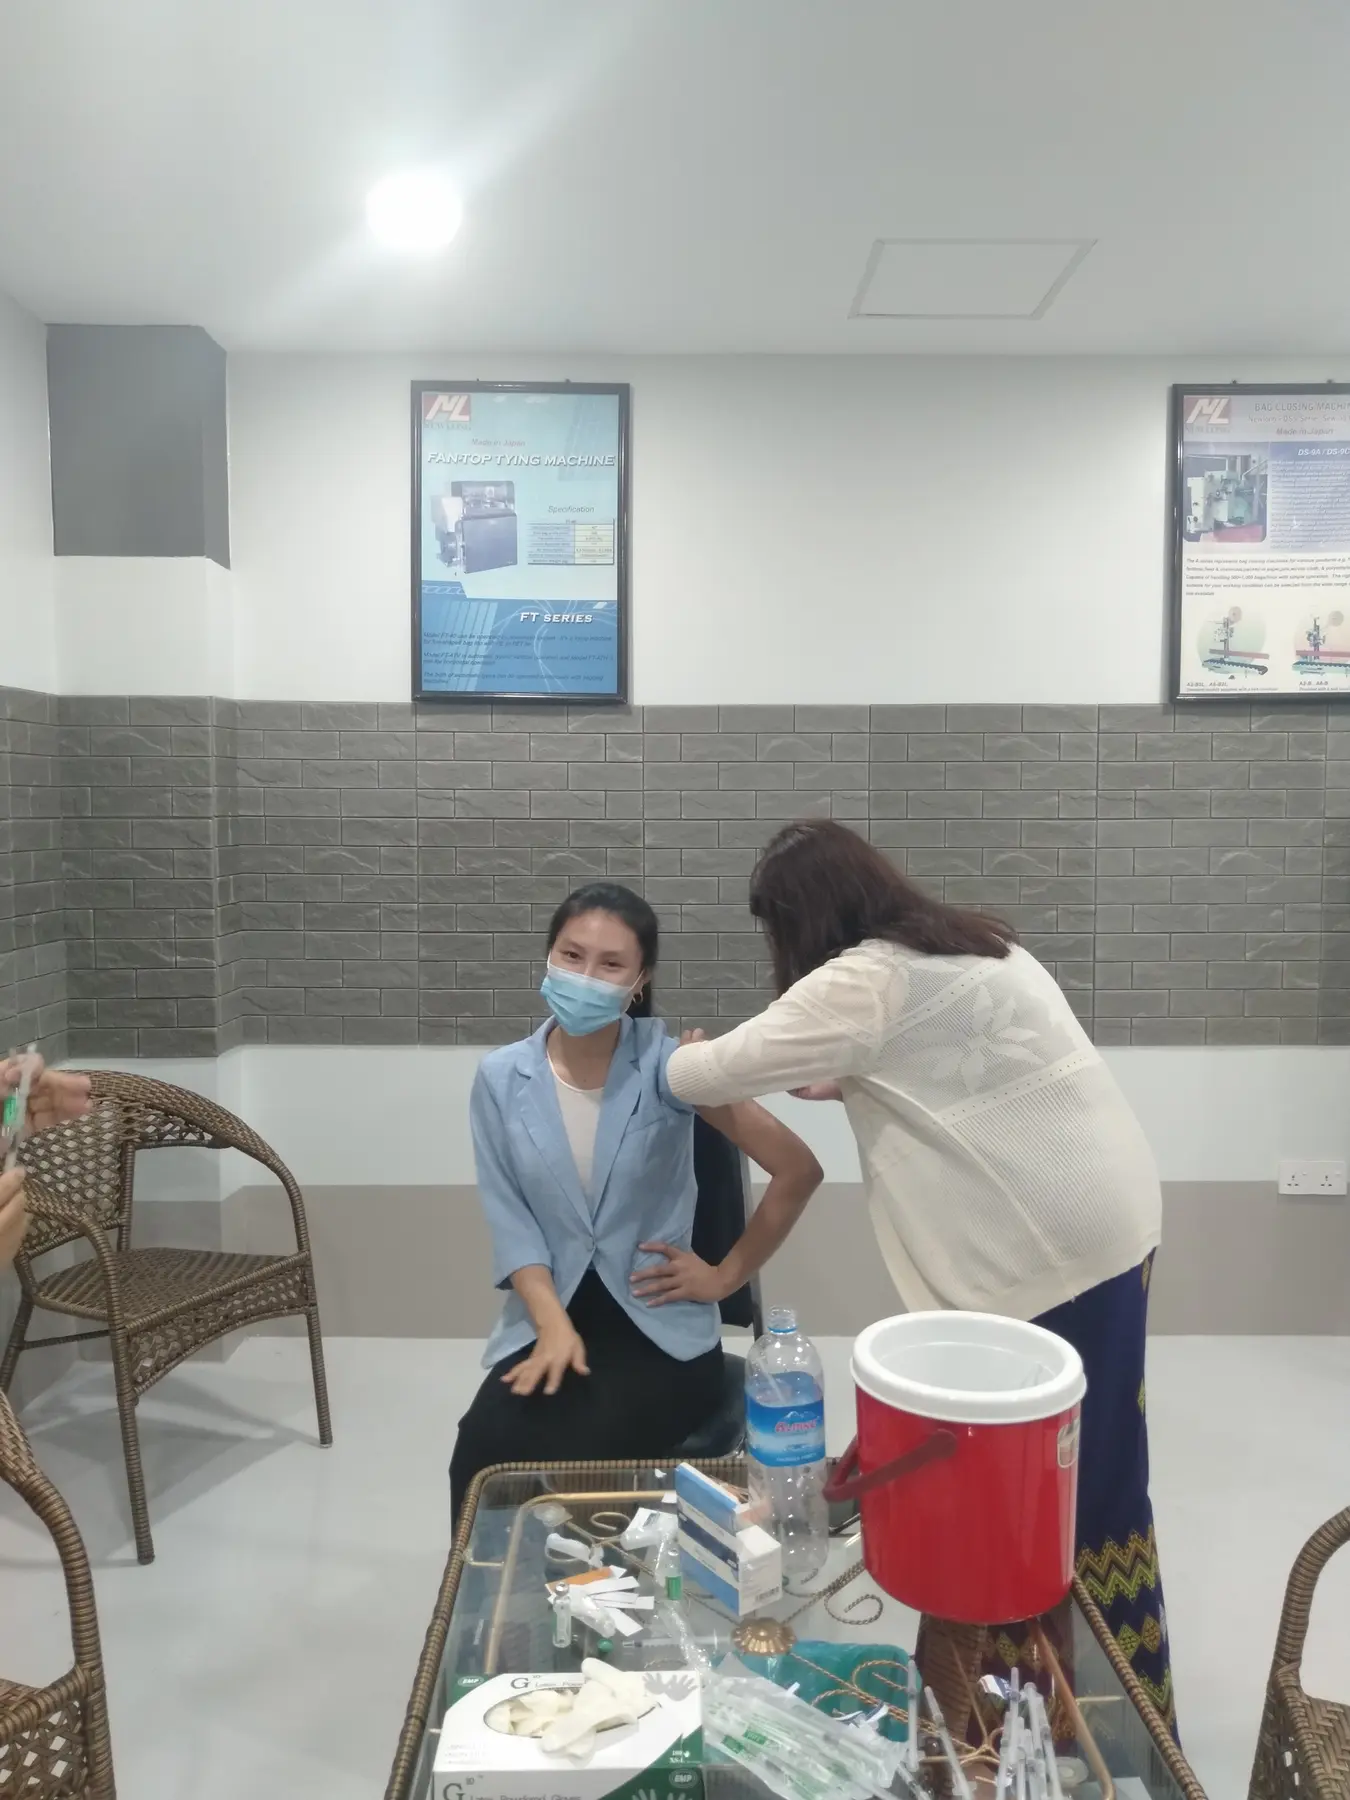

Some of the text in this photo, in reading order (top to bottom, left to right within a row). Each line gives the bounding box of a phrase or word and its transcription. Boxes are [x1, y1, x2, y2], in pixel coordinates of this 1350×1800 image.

[1275, 402, 1314, 412] CLOSING
[1276, 427, 1298, 435] Made
[1308, 427, 1334, 437] Japan
[472, 438, 491, 446] Made
[503, 439, 526, 448] Japan
[496, 454, 541, 466] TYING
[544, 455, 615, 467] MACHINE
[548, 505, 595, 515] Specification
[520, 612, 593, 623] FT SERIES
